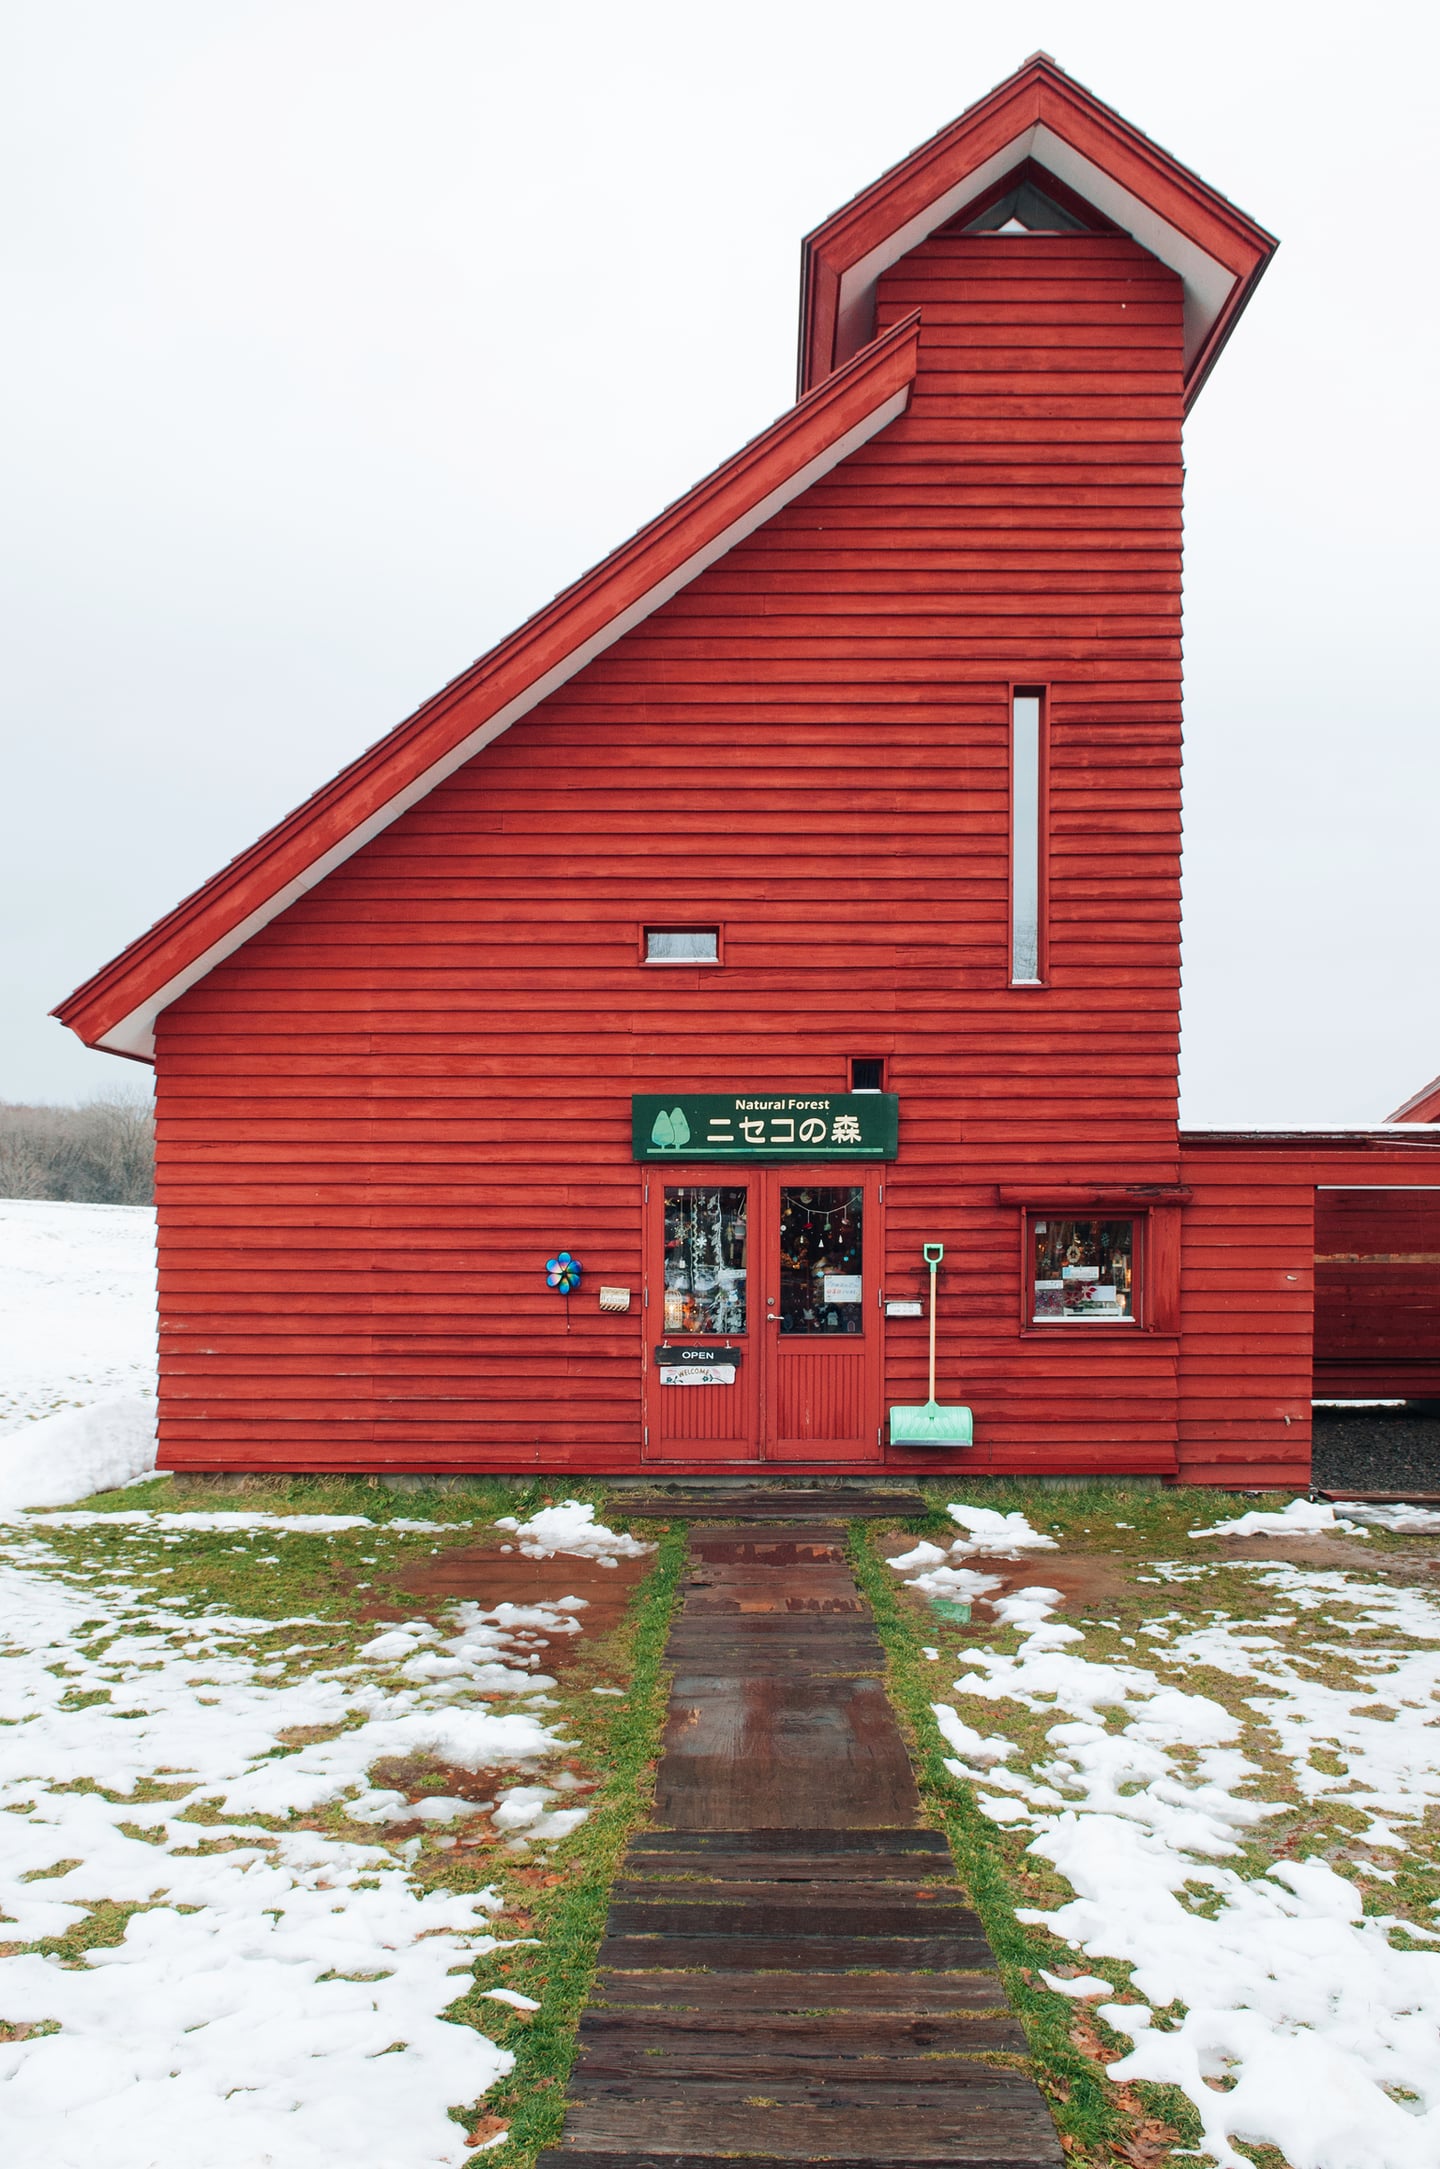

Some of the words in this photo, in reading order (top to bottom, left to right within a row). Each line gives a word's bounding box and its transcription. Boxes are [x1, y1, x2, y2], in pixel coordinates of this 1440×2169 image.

[735, 1099, 785, 1110] Natural
[788, 1099, 830, 1110] Forest
[707, 1114, 862, 1144] ニセコの森
[681, 1351, 715, 1360] OPEN
[678, 1367, 710, 1377] WELCOME
